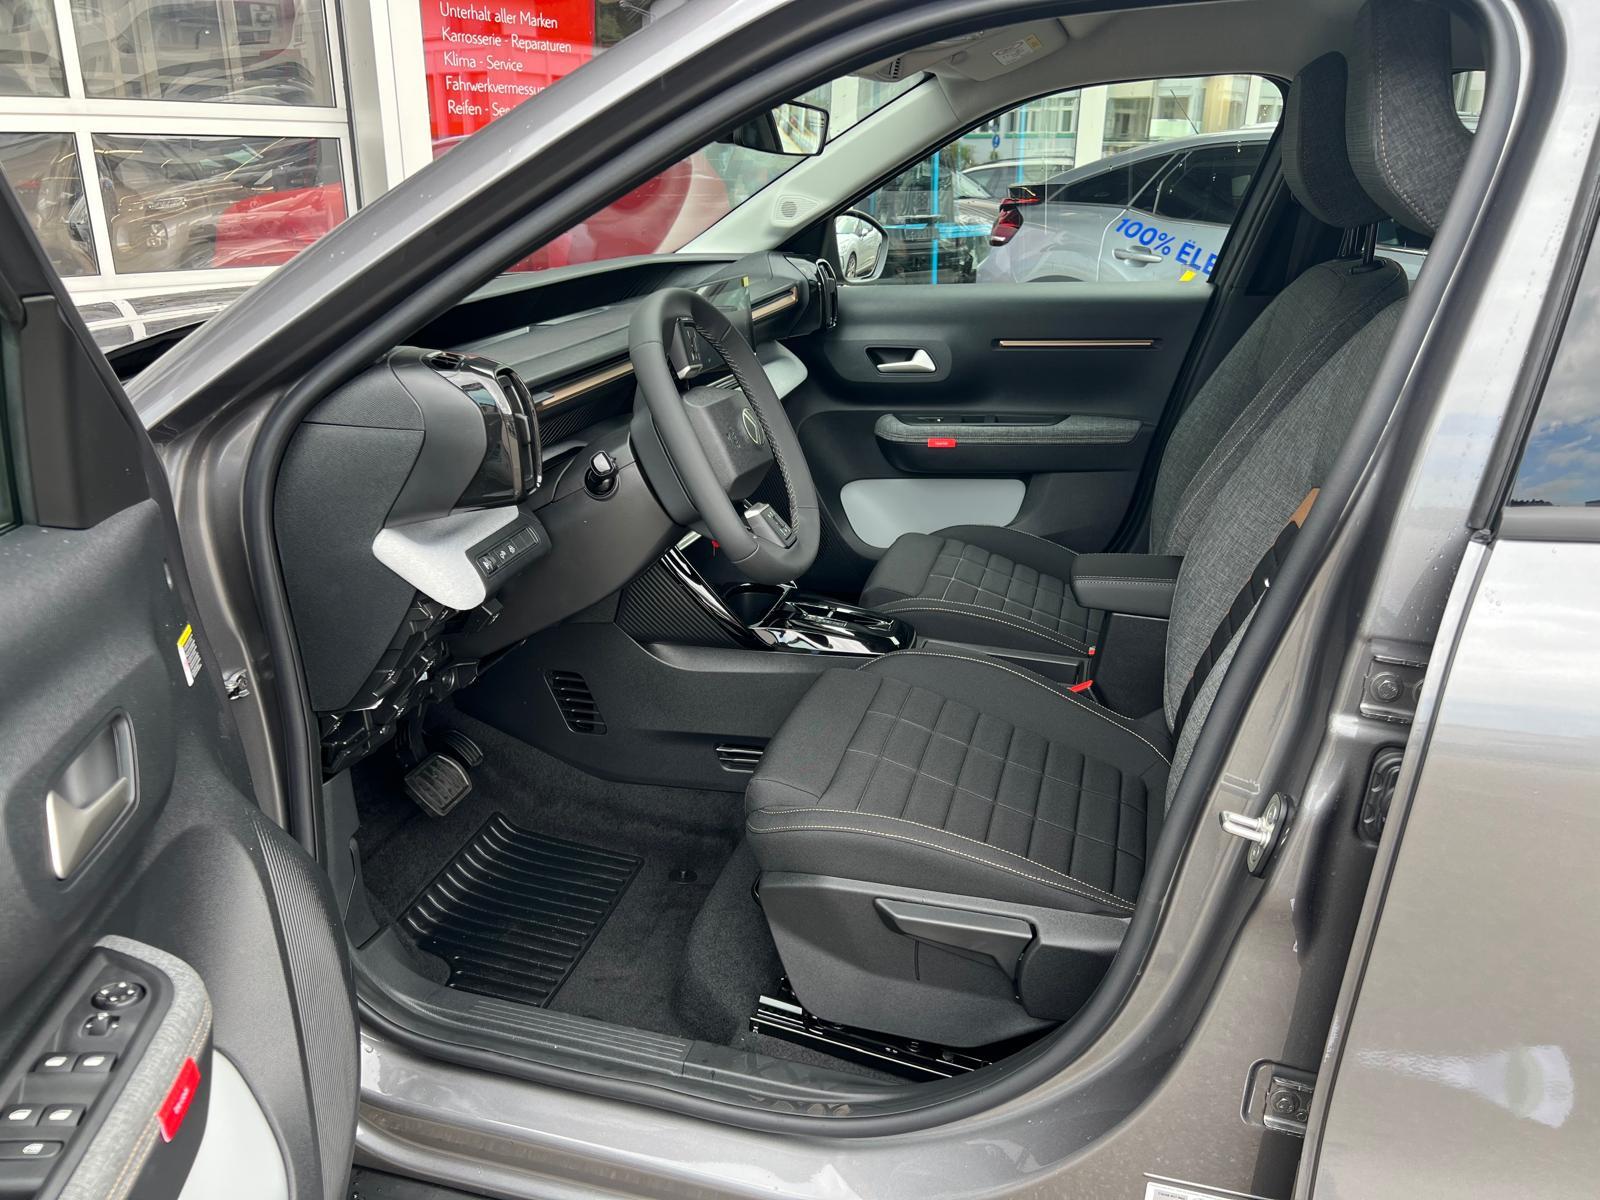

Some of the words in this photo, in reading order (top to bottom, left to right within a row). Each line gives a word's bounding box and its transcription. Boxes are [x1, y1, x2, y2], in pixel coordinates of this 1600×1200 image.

[439, 1, 491, 22] Unterhalt
[494, 8, 517, 24] aller
[520, 11, 558, 28] Marken
[441, 26, 501, 46] Karrosserie
[511, 34, 572, 53] Reparaturen
[443, 51, 477, 68] Klima
[486, 55, 523, 71] Service
[447, 100, 482, 116] Reifen
[1115, 218, 1176, 256] 100%
